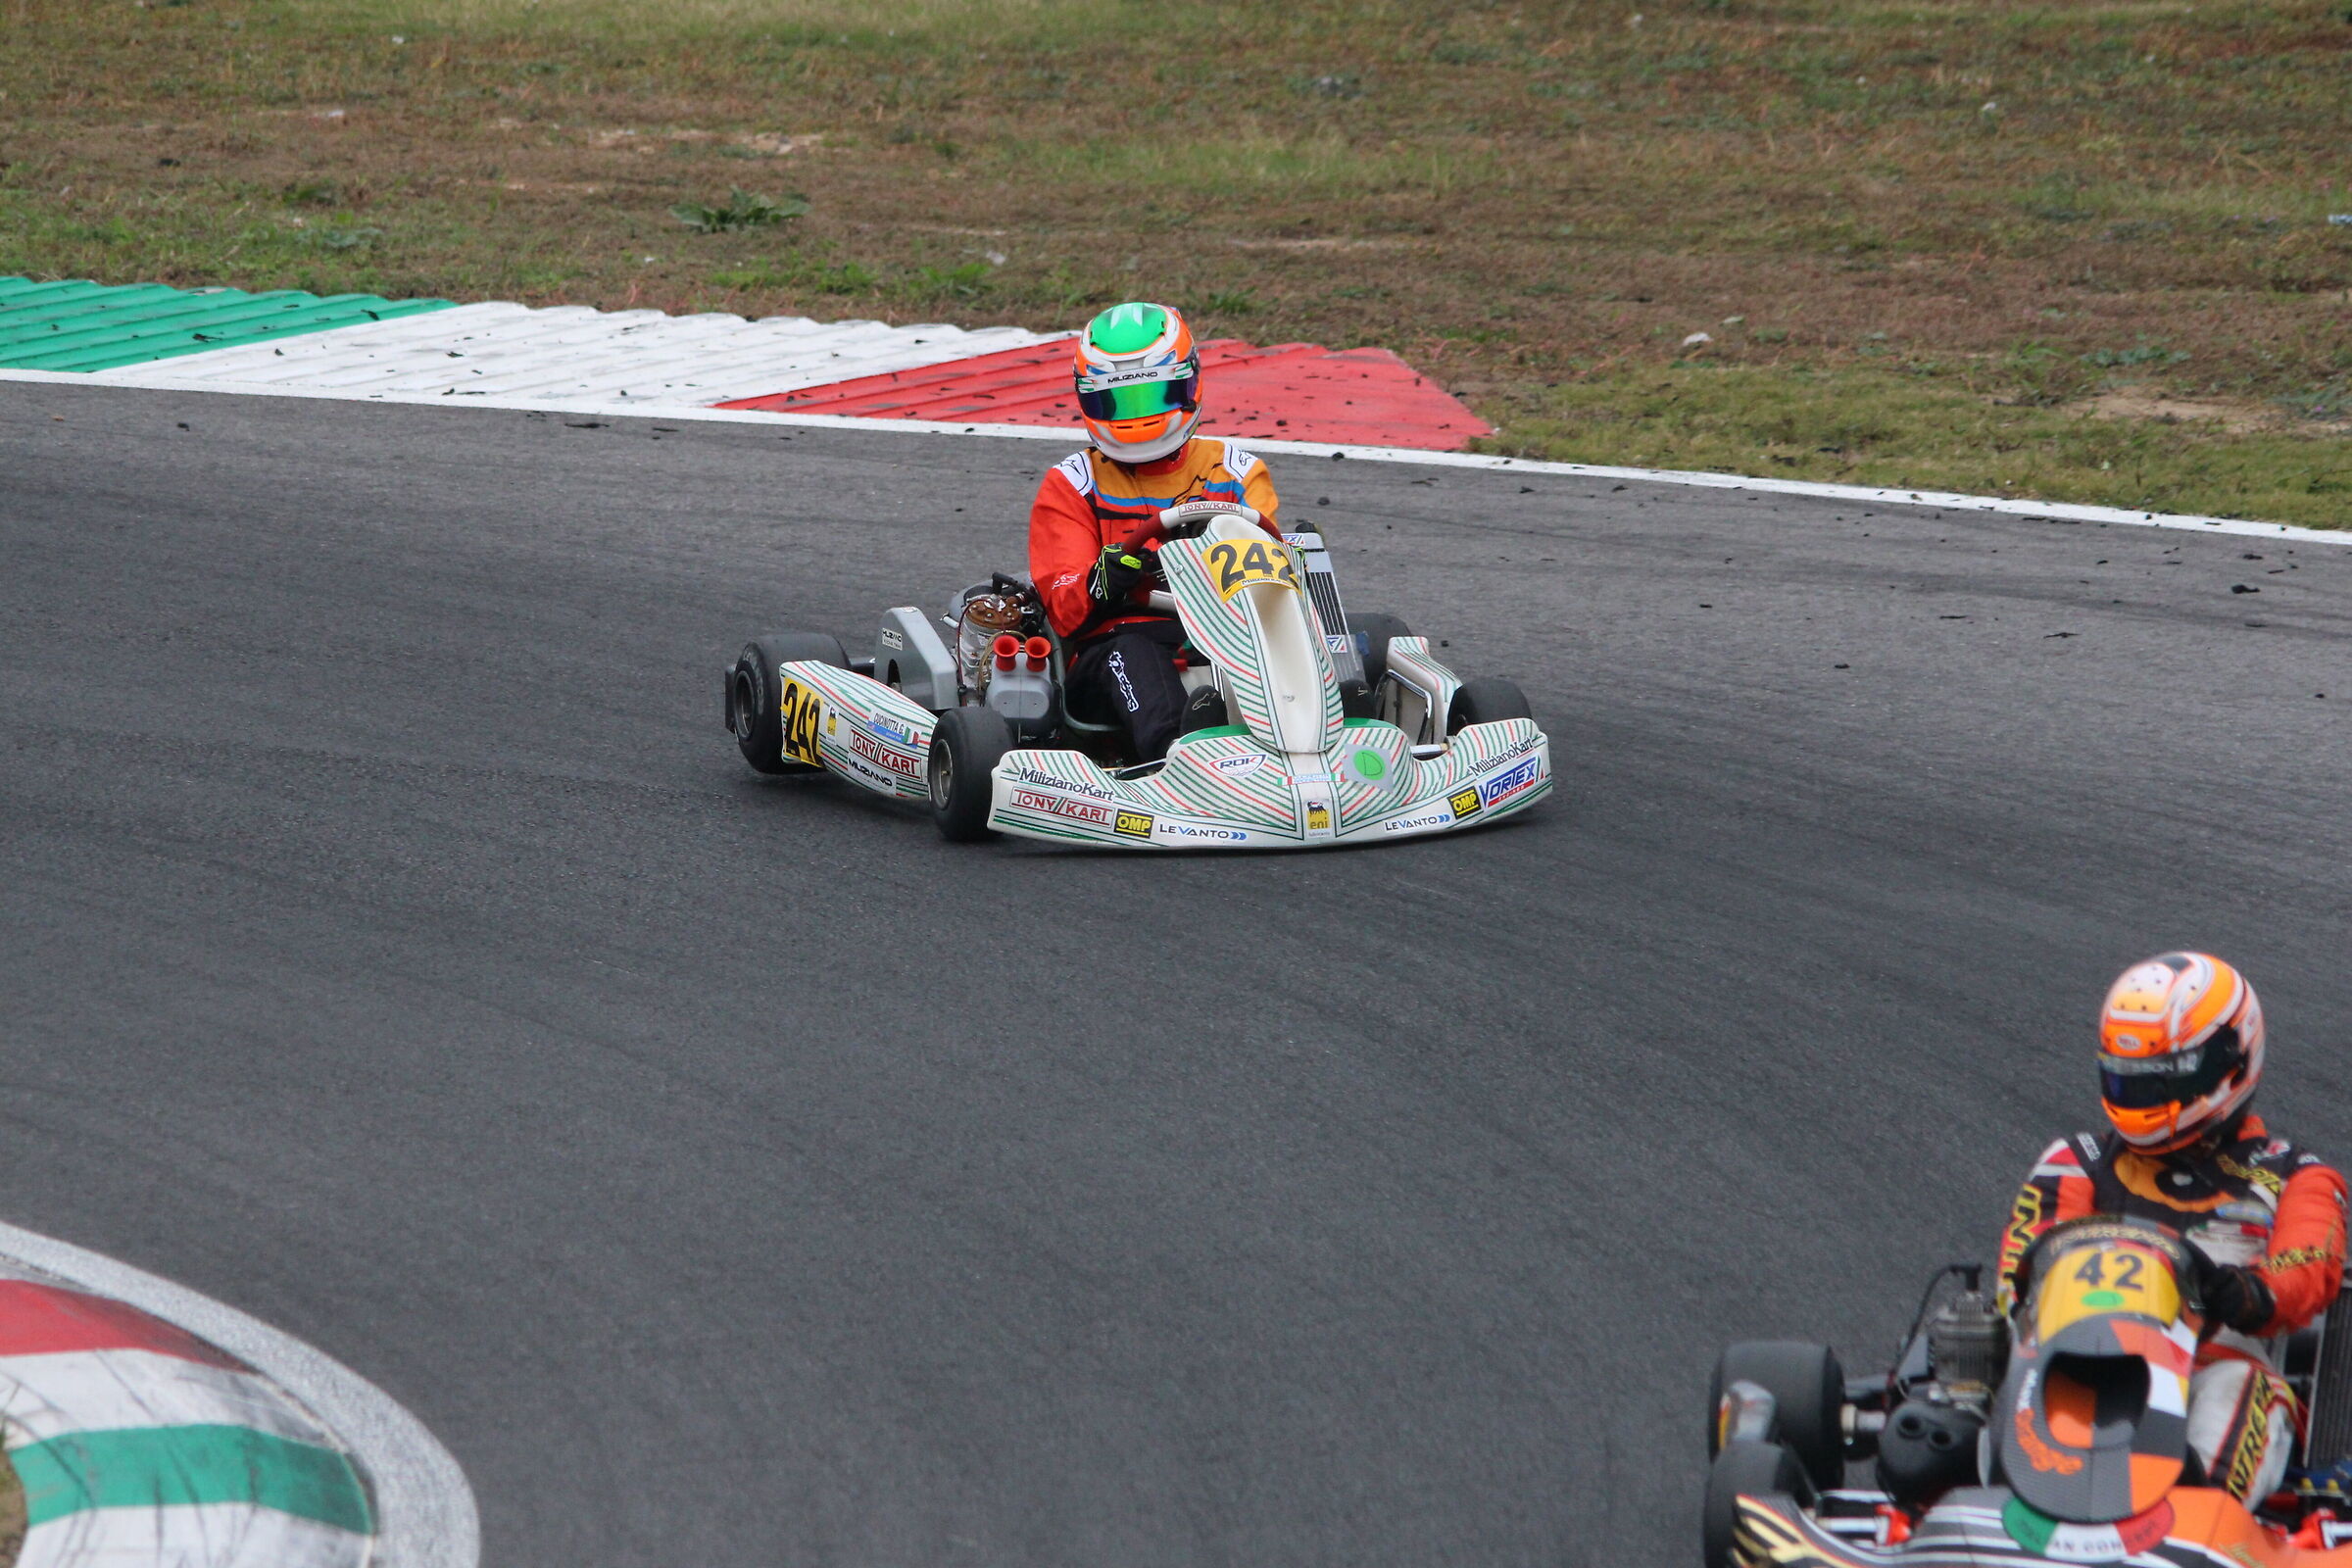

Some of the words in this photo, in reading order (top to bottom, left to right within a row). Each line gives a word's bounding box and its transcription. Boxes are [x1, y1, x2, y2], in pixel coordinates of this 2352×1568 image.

[1210, 542, 1300, 594] 242
[784, 682, 825, 767] 242
[1019, 766, 1114, 802] MilizianoKart
[1479, 756, 1537, 808] VORTEX
[1452, 793, 1478, 812] OMP
[1117, 813, 1152, 833] OMP
[1310, 816, 1329, 830] eni
[2074, 1252, 2144, 1293] 42
